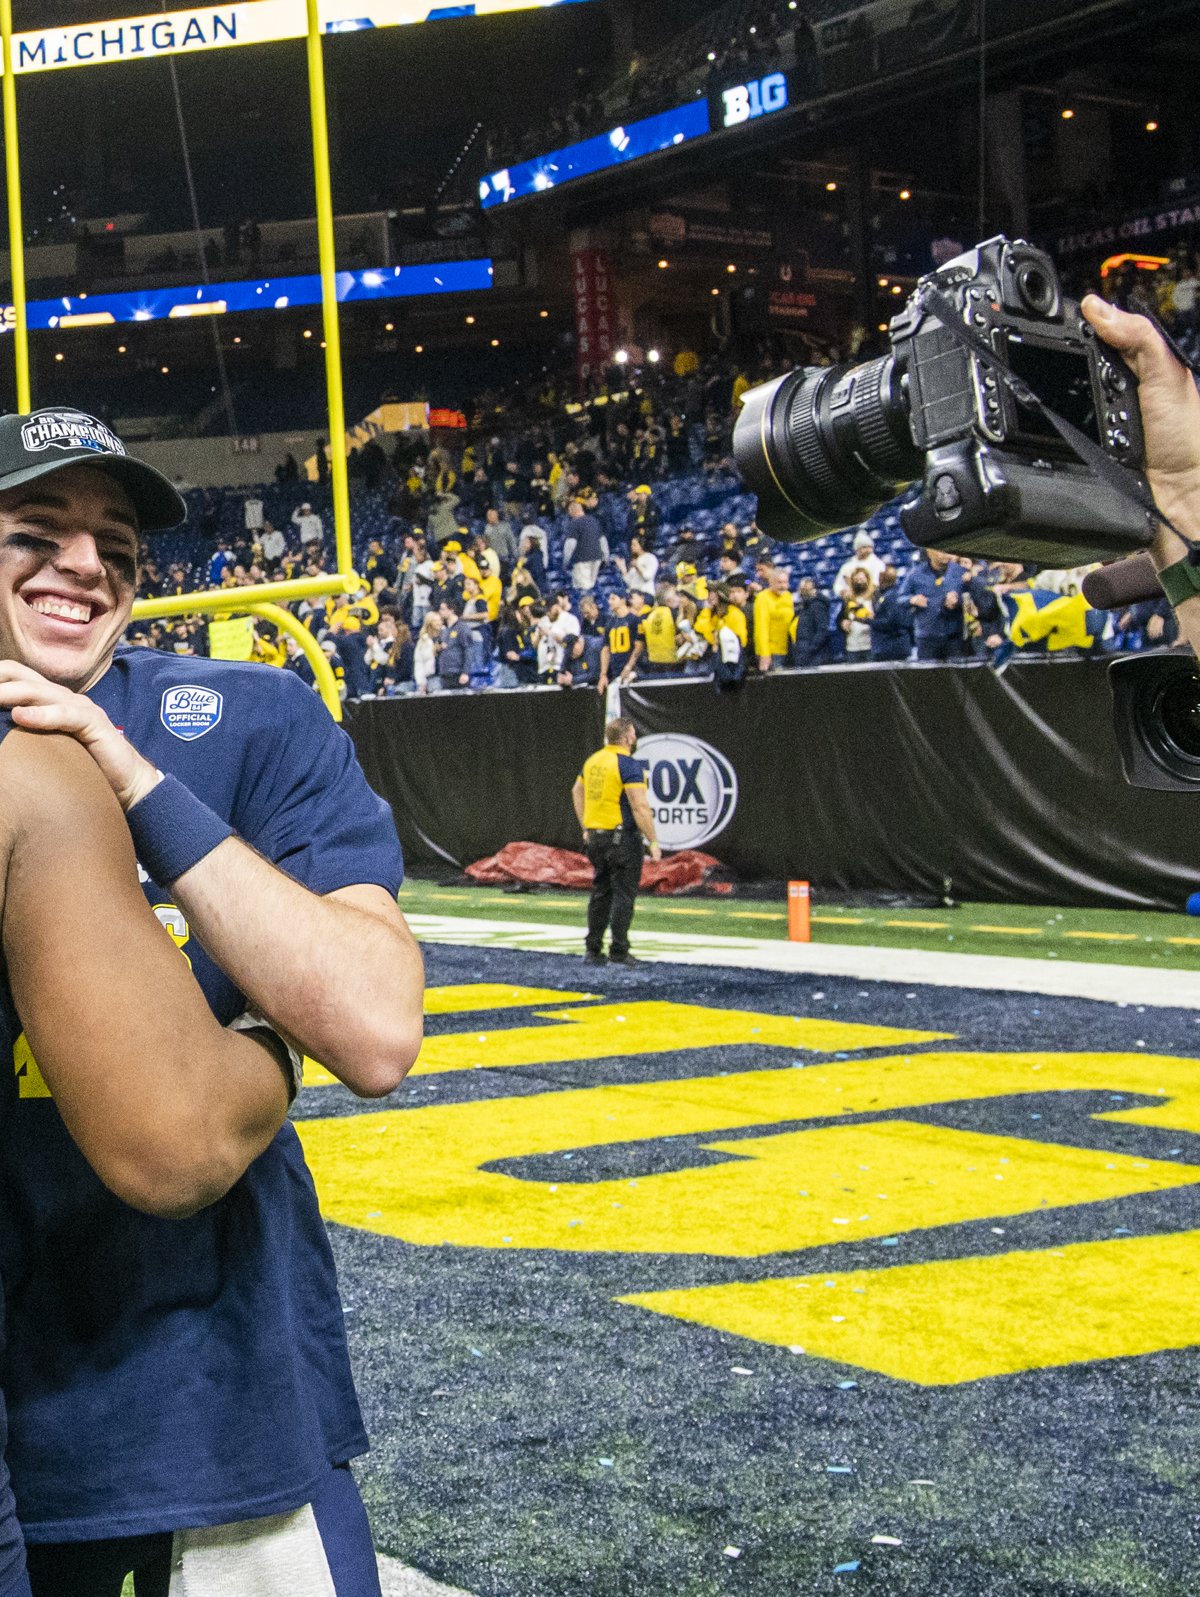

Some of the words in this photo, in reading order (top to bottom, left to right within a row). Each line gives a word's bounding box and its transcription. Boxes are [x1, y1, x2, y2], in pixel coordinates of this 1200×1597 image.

[19, 13, 237, 67] MICHIGAN
[25, 421, 127, 456] CHAMPIONS
[609, 625, 630, 654] 10
[169, 690, 215, 710] Blue
[168, 714, 212, 722] OFFICIAL
[650, 807, 709, 825] ORTS
